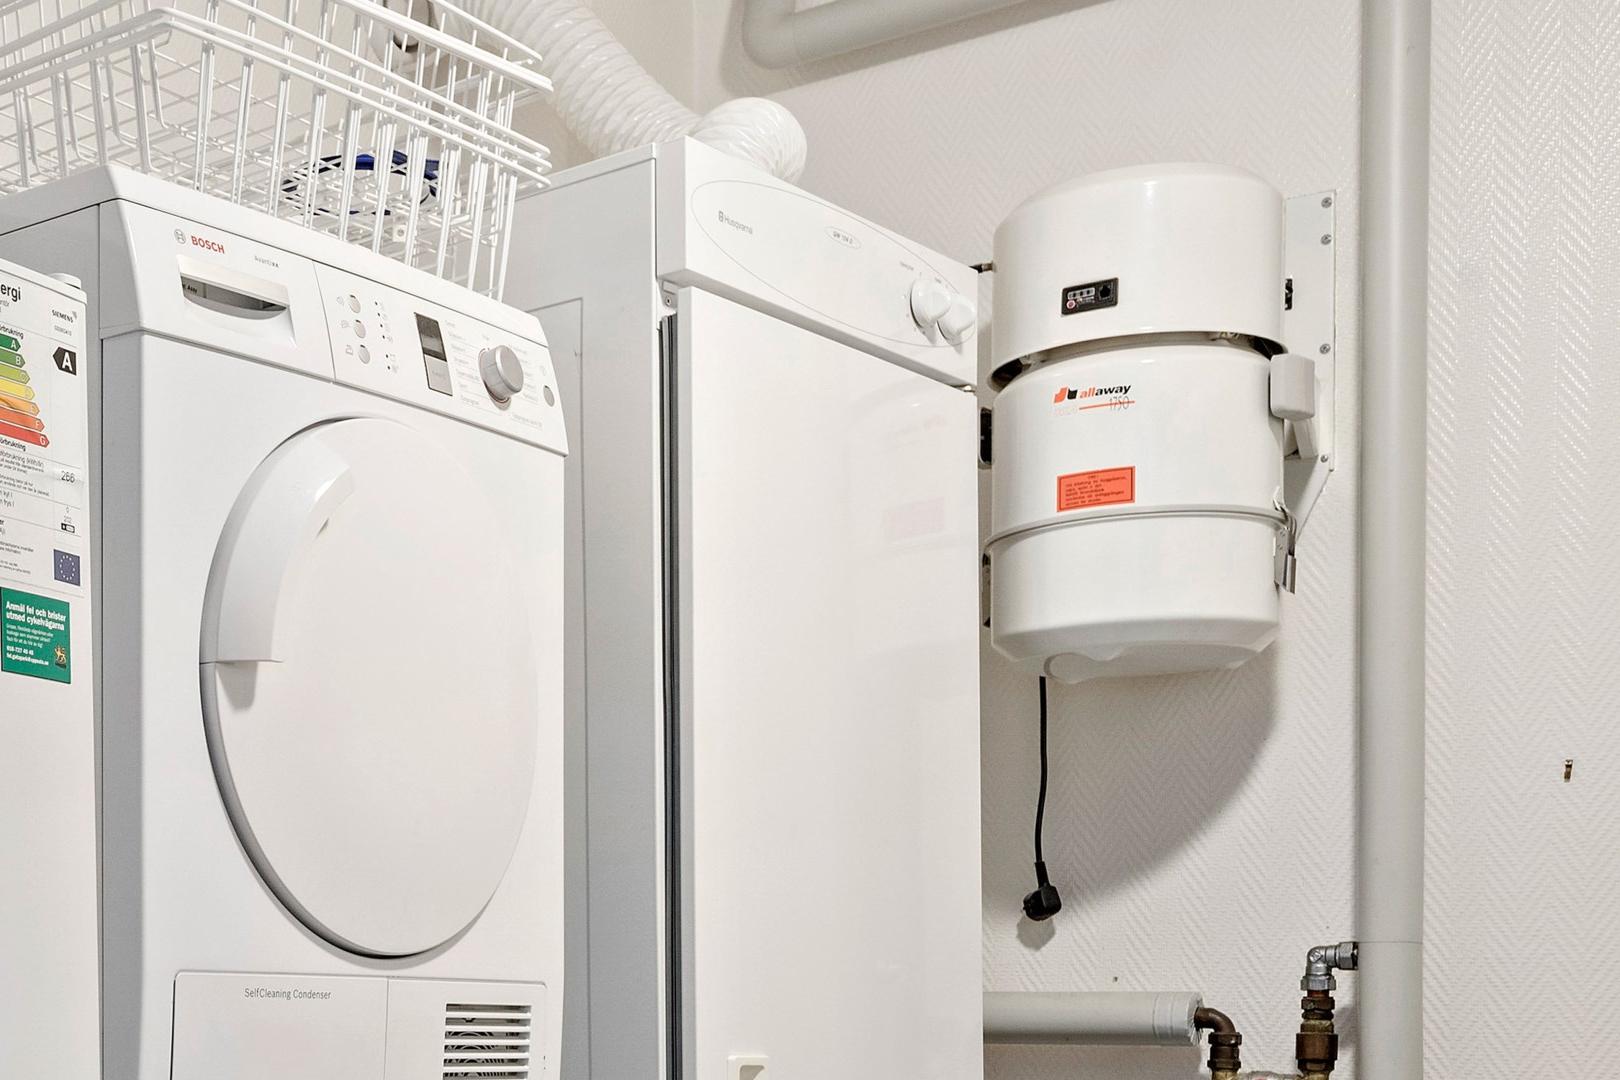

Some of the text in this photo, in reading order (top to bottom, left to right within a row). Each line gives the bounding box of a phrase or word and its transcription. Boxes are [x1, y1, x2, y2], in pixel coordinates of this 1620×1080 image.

[724, 215, 754, 235] Husqvarna
[191, 235, 225, 254] BOSCH
[52, 309, 74, 323] SIEMENS
[10, 340, 17, 350] A
[16, 355, 21, 366] B
[62, 352, 73, 372] A
[21, 372, 27, 382] C
[1080, 385, 1132, 399] allaway
[35, 420, 40, 429] F
[40, 436, 46, 445] G
[61, 470, 75, 484] 266
[5, 600, 66, 622] Anmäl fel och brister
[6, 611, 64, 631] utmed cykelvägarna
[244, 987, 331, 1001] SelfCleaning Condenser
